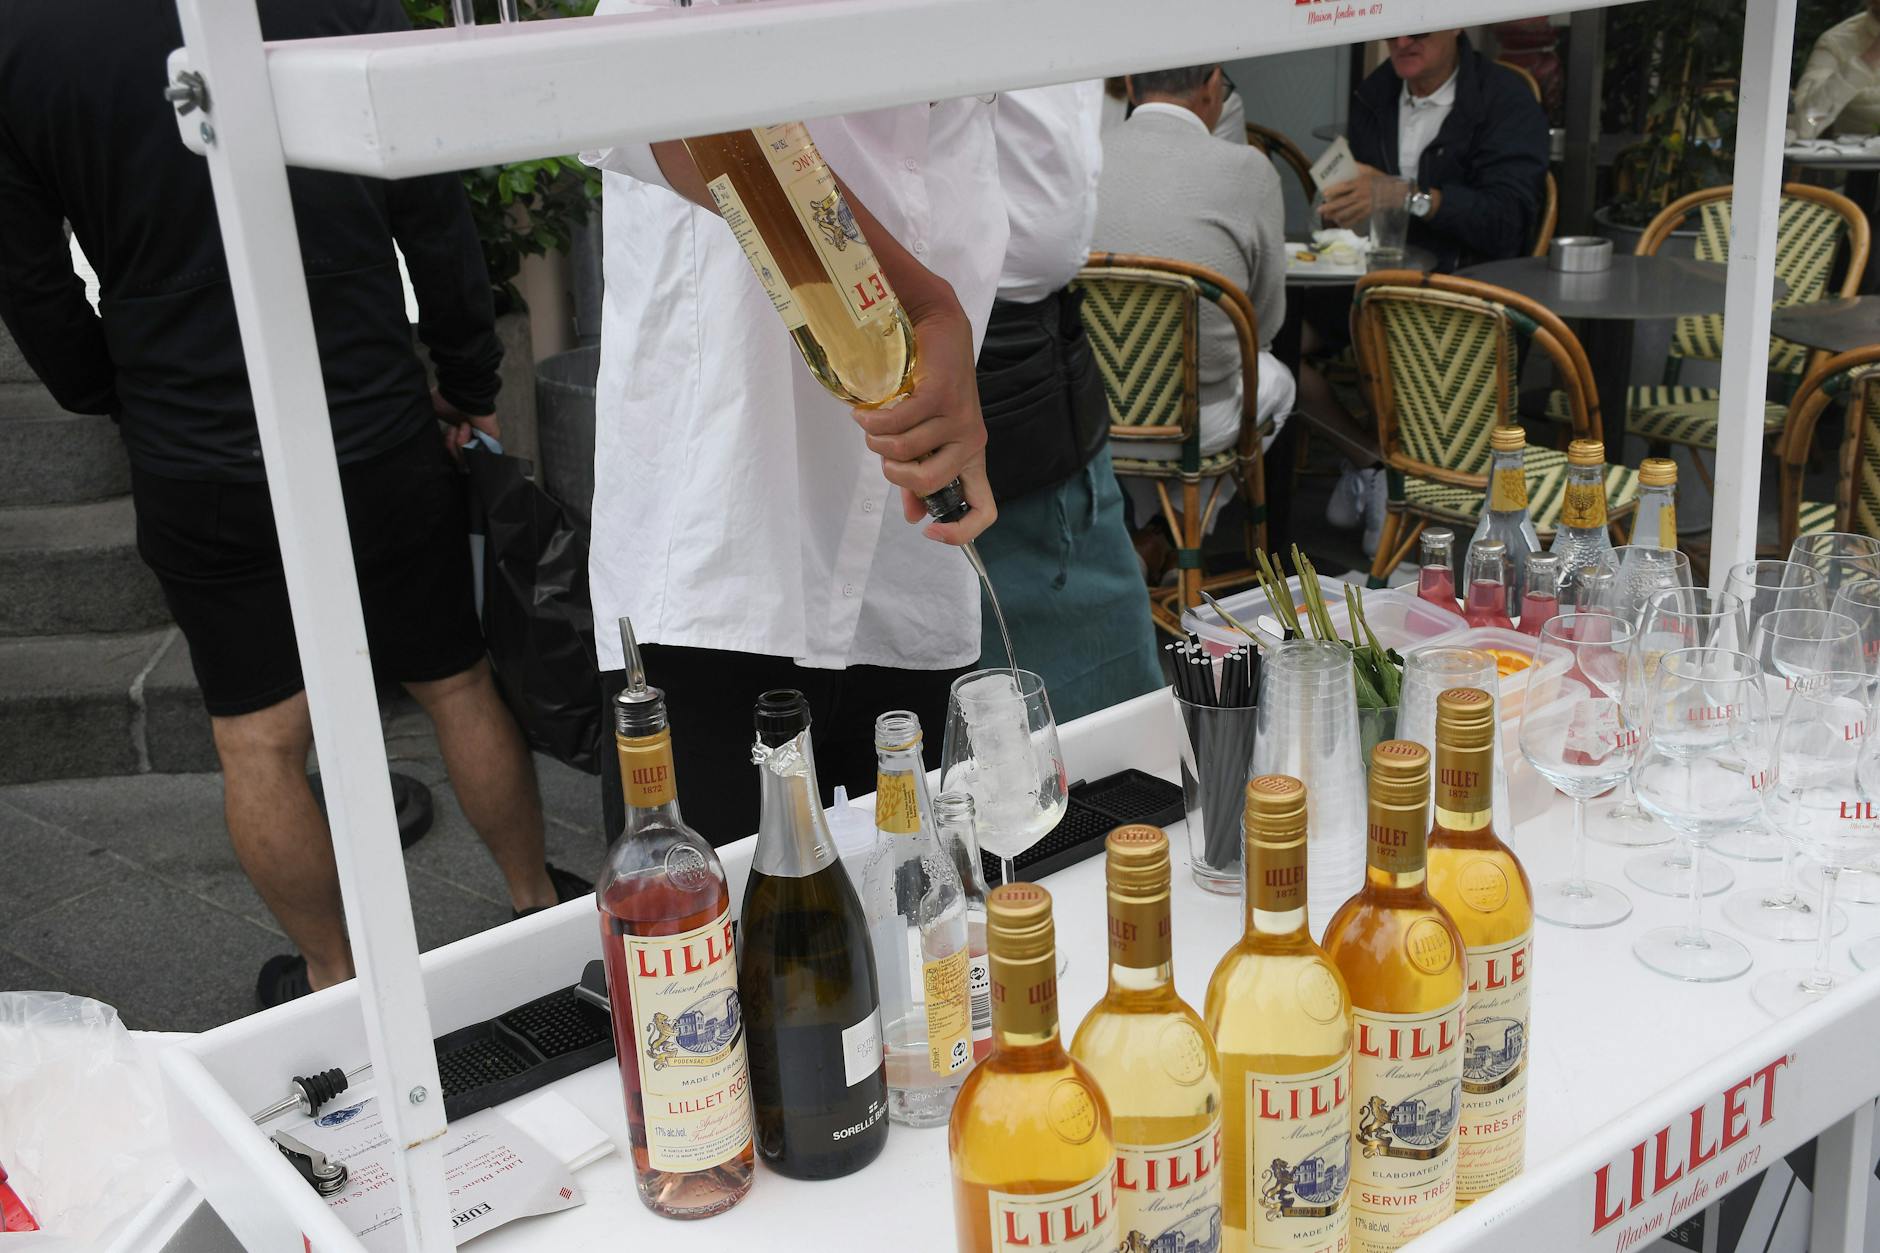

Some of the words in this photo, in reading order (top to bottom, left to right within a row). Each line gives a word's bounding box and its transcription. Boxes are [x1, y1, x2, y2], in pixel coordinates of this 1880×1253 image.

[1308, 11, 1332, 25] Maison
[632, 765, 669, 785] LILLET
[1441, 768, 1479, 788] LILLET
[1449, 789, 1469, 799] 1872
[1370, 824, 1408, 848] LILLET
[1376, 846, 1397, 857] 1872
[1265, 865, 1304, 887] LILLET
[1276, 888, 1297, 899] 1872
[637, 920, 734, 978] LILLE
[682, 1076, 708, 1087] MADE
[712, 1071, 720, 1080] IN
[1376, 1064, 1421, 1080] Maison
[668, 1091, 724, 1114] LILLET
[729, 1071, 747, 1098] ROS
[833, 1115, 875, 1141] SORELLE
[1281, 1124, 1323, 1140] Maison
[1474, 1120, 1508, 1136] TRÈS
[1592, 1054, 1790, 1236] LILLET
[495, 1159, 524, 1177] Lillet
[1116, 1125, 1221, 1194] LILLE
[1372, 1164, 1440, 1179] ELABORATED
[463, 1173, 495, 1190] Blanc
[1139, 1196, 1183, 1212] Maison
[1361, 1192, 1418, 1206] SERVIR
[1616, 1211, 1664, 1253] Maison
[1666, 1177, 1710, 1233] fondée
[1716, 1170, 1729, 1187] en
[1737, 1144, 1761, 1177] 1872
[1293, 1228, 1323, 1240] MADE
[1326, 1223, 1335, 1232] IN
[1355, 1217, 1367, 1230] 17%
